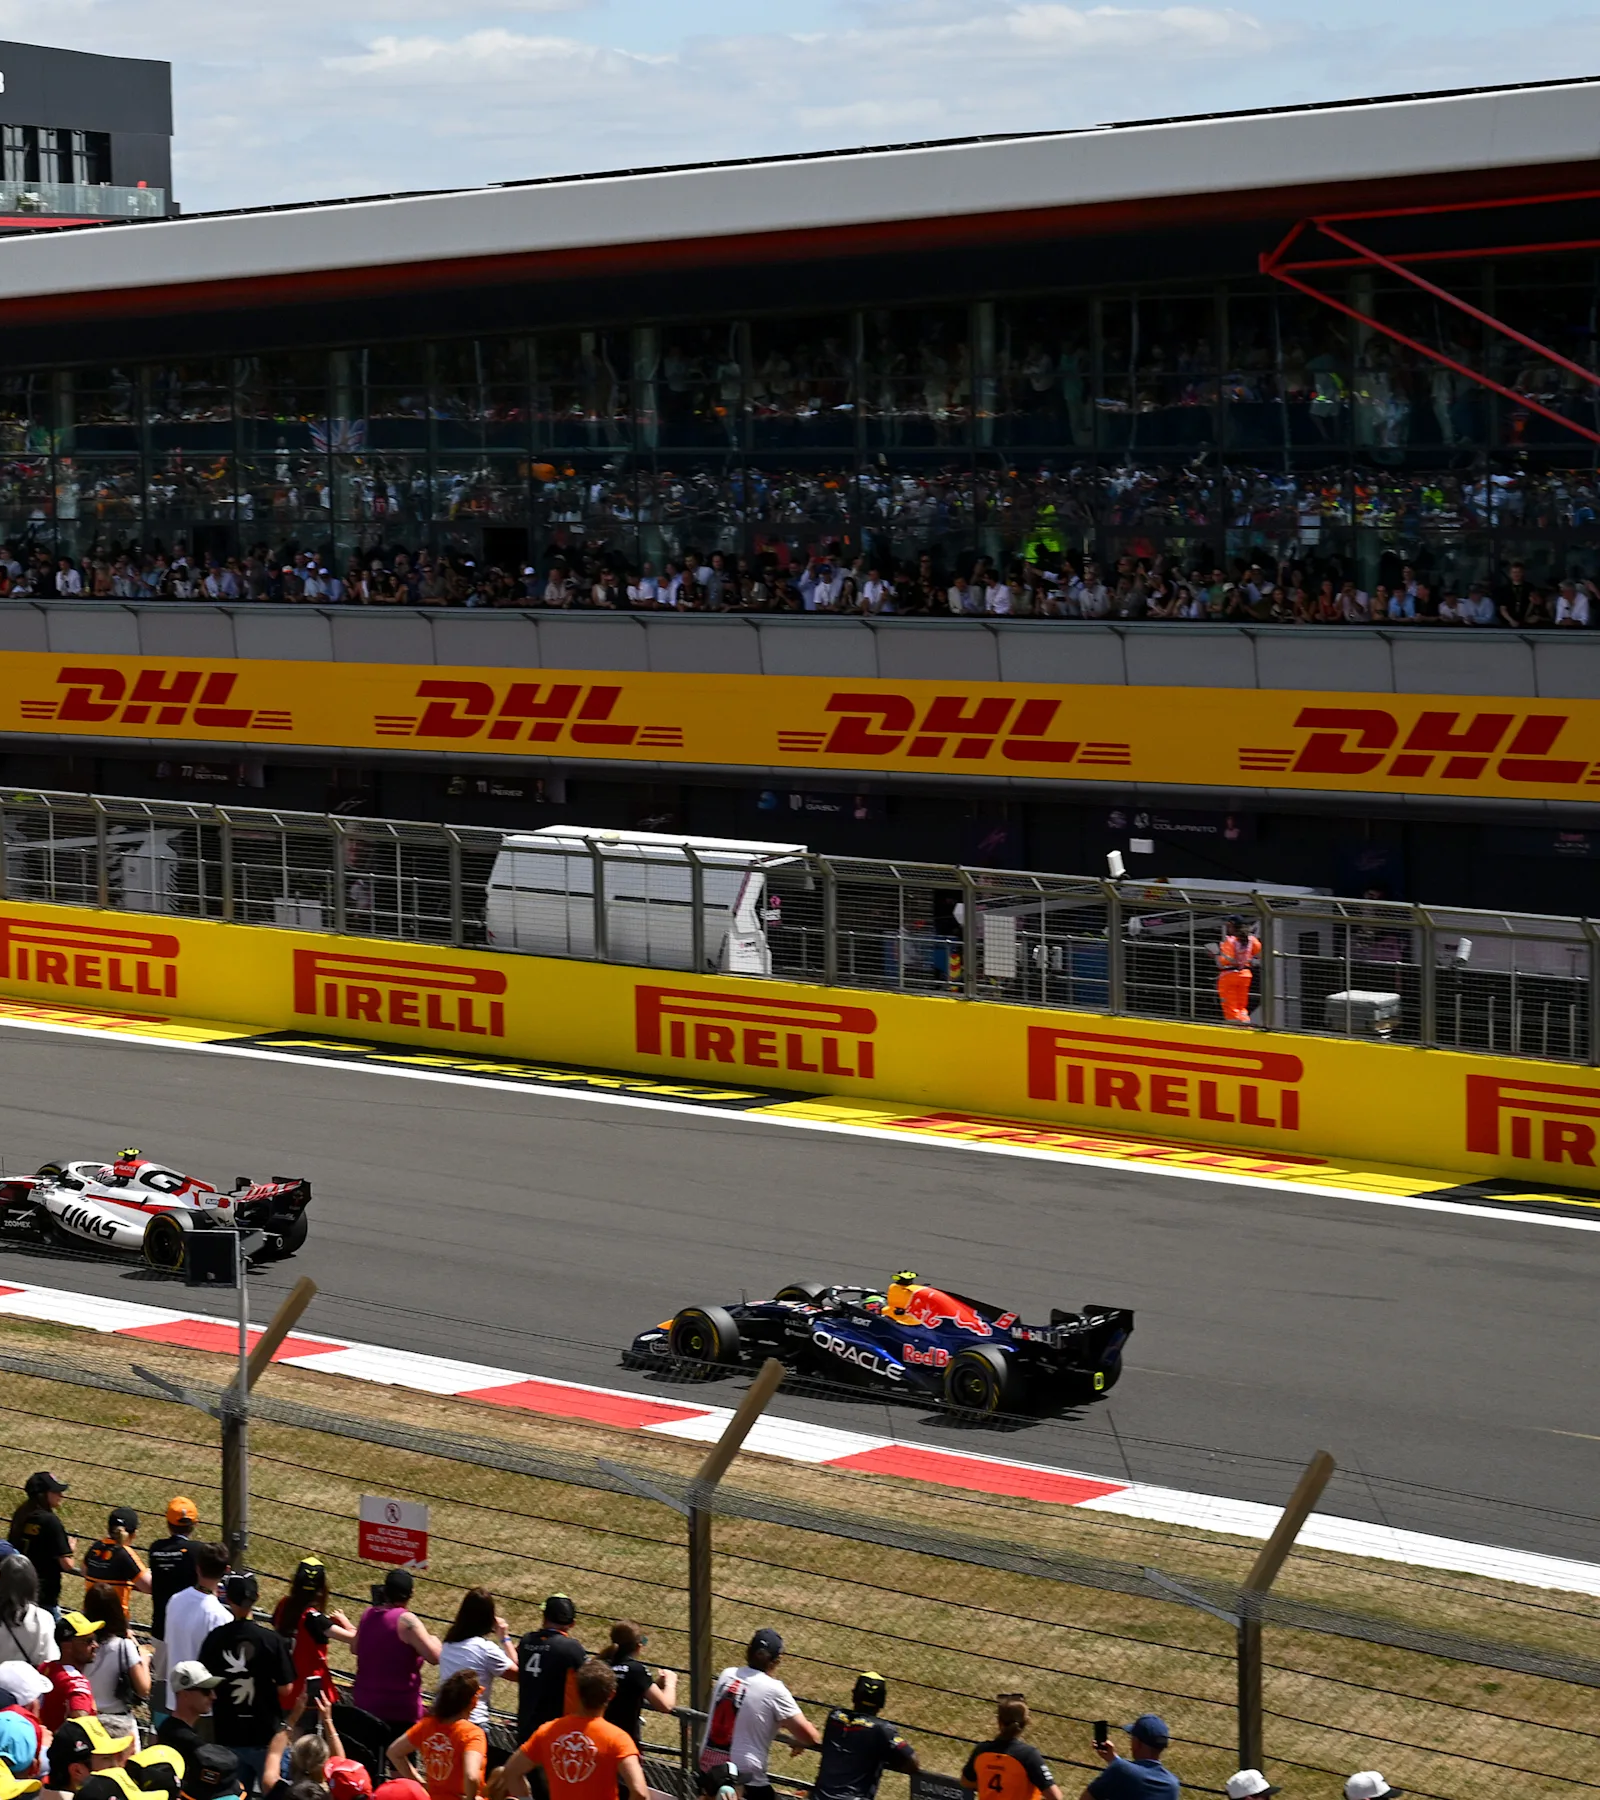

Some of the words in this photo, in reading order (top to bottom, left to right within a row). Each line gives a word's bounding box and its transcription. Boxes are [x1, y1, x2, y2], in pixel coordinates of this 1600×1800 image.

[56, 667, 254, 729] DHL
[415, 680, 639, 745] DHL
[824, 693, 1080, 763] DHL
[1292, 707, 1591, 785] DHL
[181, 765, 193, 777] 77
[1152, 823, 1217, 834] COLAPINTO
[295, 950, 507, 1037] PIRELLI
[636, 986, 877, 1079] PIRELLI
[1029, 1026, 1303, 1131] PIRELLI
[4, 1220, 31, 1229] ZOOMEX
[56, 1205, 129, 1240] HAAS
[812, 1331, 906, 1382] ORACLE
[903, 1344, 934, 1367] Red
[524, 1653, 543, 1678] 4
[920, 1780, 964, 1800] DANGER
[988, 1774, 1004, 1793] 4
